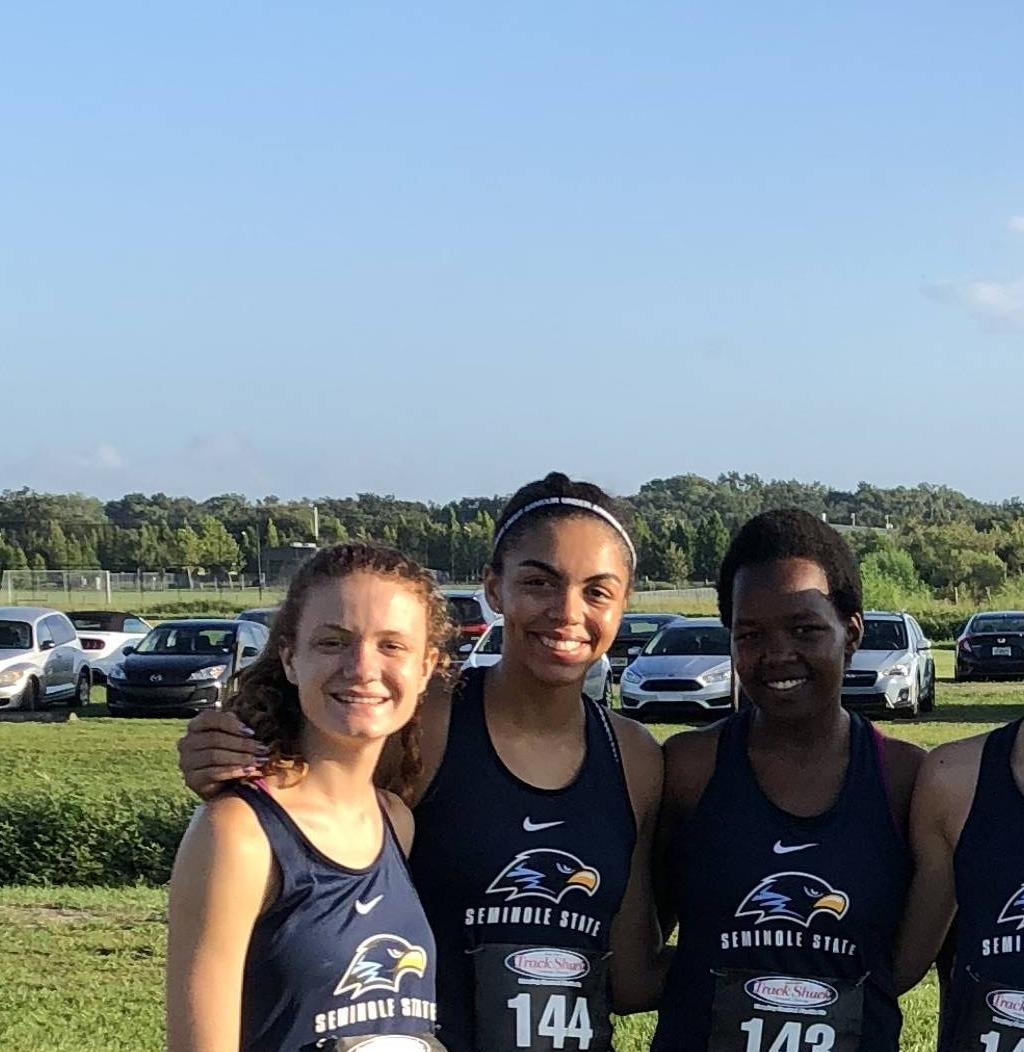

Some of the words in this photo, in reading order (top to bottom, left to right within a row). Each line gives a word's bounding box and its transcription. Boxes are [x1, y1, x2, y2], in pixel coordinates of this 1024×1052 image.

[464, 906, 552, 926] SEMINOLE
[559, 910, 602, 937] STATE
[720, 929, 803, 949] SEMINOLE
[812, 934, 857, 956] STATE
[314, 998, 395, 1034] SEMINOLE
[401, 997, 437, 1021] STATE
[507, 993, 594, 1050] 144
